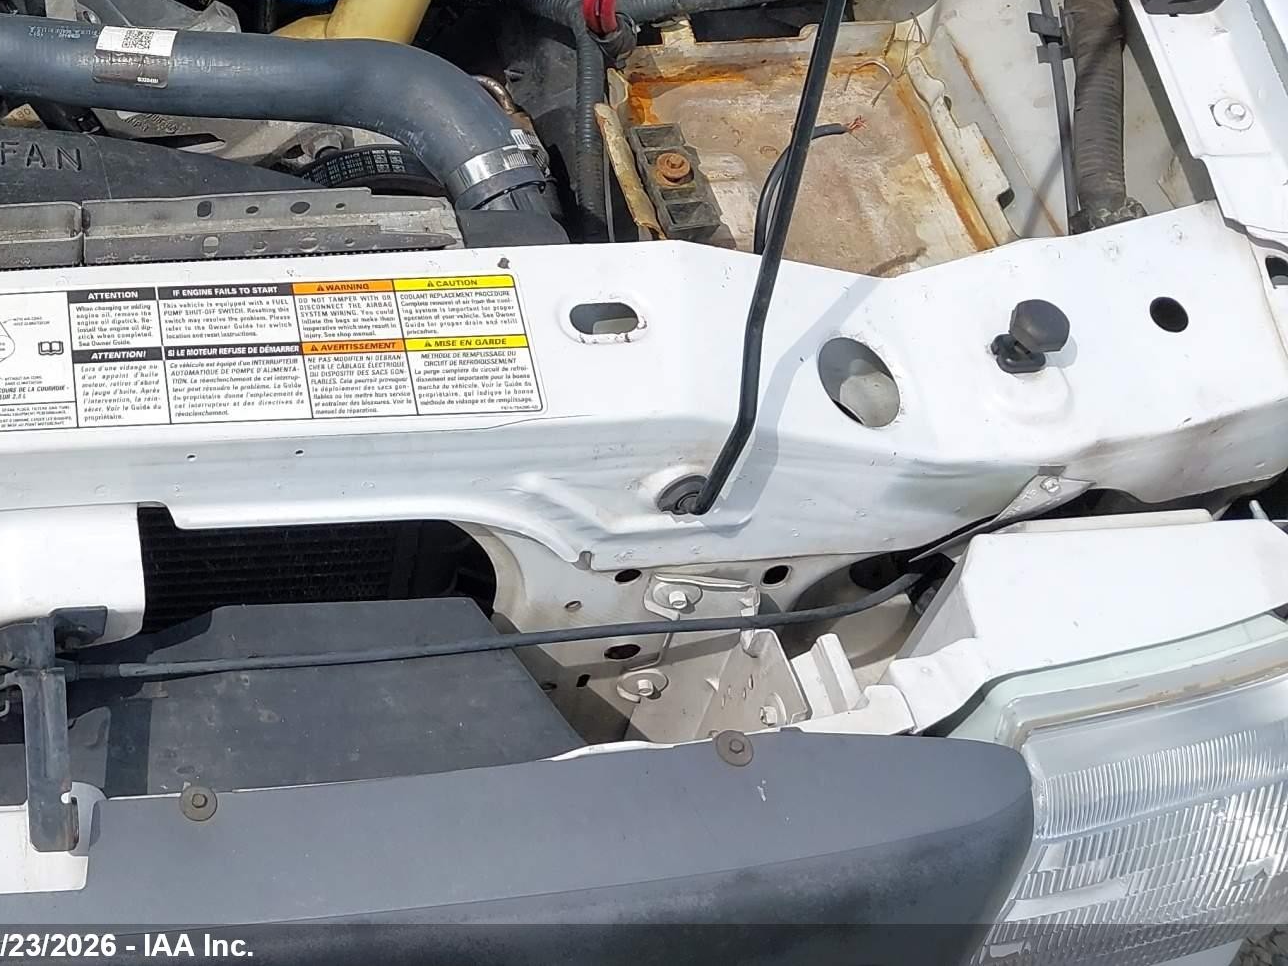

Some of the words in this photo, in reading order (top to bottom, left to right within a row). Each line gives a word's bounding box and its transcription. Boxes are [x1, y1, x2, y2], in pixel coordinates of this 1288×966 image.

[0, 140, 84, 172] FAN
[326, 283, 370, 291] WARNING
[436, 279, 478, 287] CAUTION
[88, 291, 138, 300] ATTENTION
[173, 289, 179, 297] IF
[182, 288, 212, 296] ENGINE
[239, 287, 250, 295] TO
[252, 286, 278, 294] START
[321, 342, 396, 351] AVERTISSEMENT
[434, 339, 457, 347] MISE
[460, 338, 472, 346] EN
[475, 337, 507, 345] GARDE
[91, 351, 146, 360] ATTENTION!
[168, 349, 176, 357] SI
[187, 348, 217, 356] MOTEUR
[219, 347, 246, 355] REFUSE
[259, 345, 300, 354] DÉMARRER
